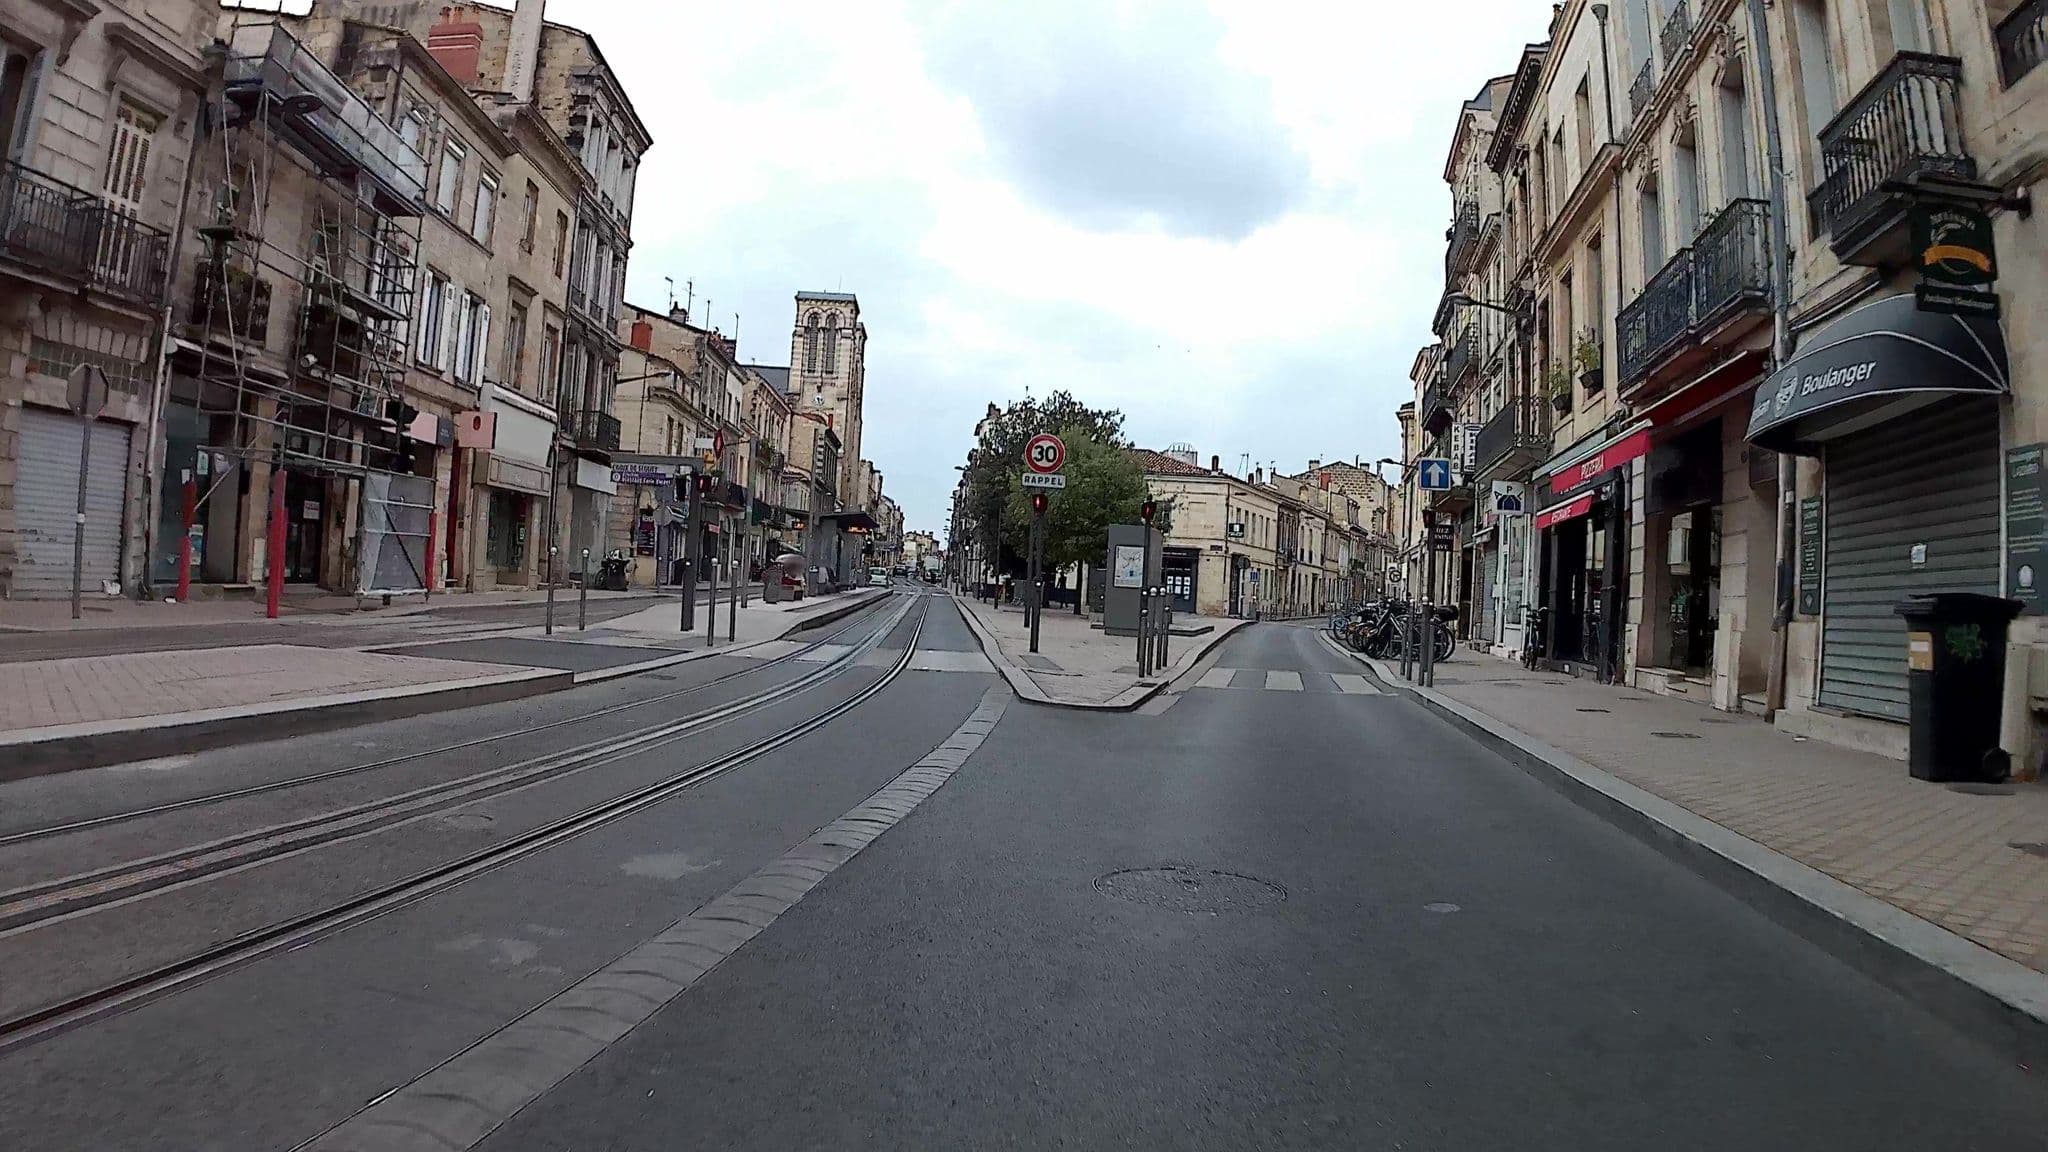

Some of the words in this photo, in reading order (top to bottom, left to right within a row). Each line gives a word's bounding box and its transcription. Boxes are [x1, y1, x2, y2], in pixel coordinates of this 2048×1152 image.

[1801, 361, 1877, 396] Boulanger
[1033, 445, 1057, 463] 30
[1024, 475, 1063, 486] RAPPEL
